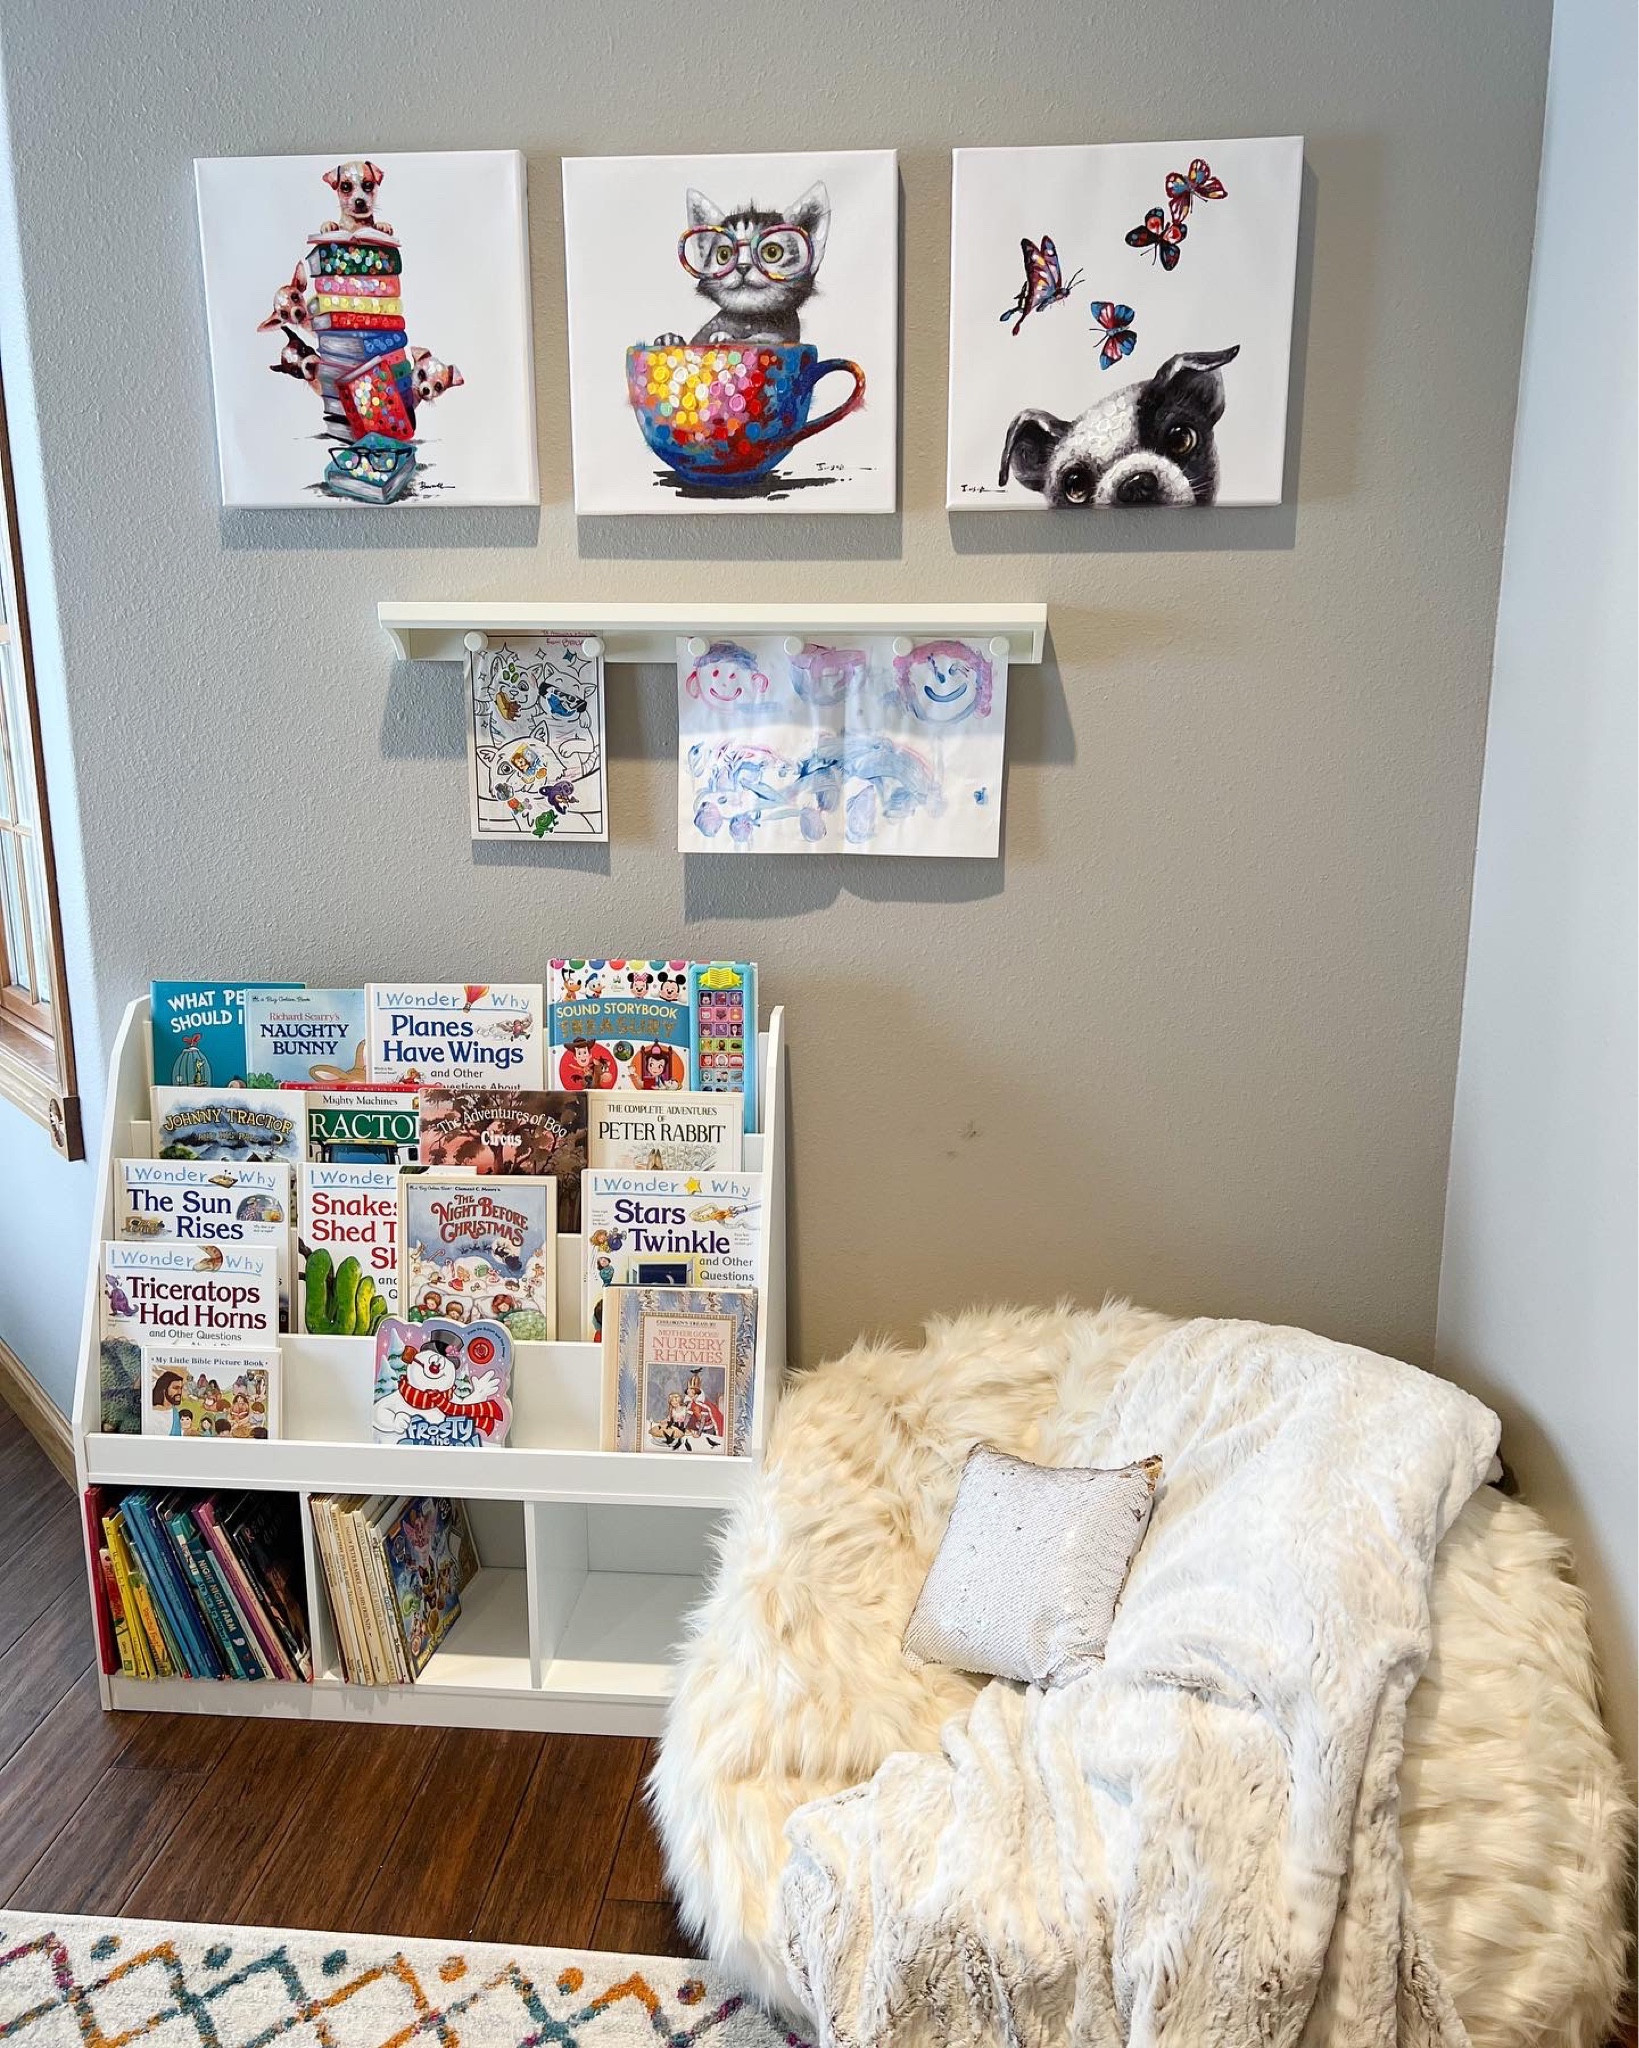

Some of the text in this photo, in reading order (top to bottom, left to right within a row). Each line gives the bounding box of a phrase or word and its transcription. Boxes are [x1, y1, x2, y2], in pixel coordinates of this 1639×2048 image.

[167, 990, 215, 1012] WHAT
[376, 991, 530, 1009] I Wonder Why
[556, 1002, 679, 1019] SOUND STORYBOOK
[170, 1009, 243, 1034] SHOULD I
[269, 1012, 340, 1022] Richard Scarry's
[391, 1014, 473, 1037] Planes
[260, 1023, 349, 1038] NAUGHTY
[272, 1040, 338, 1055] BUNNY
[383, 1040, 524, 1070] Have Wings
[430, 1068, 484, 1079] and Other
[322, 1094, 398, 1106] Mighty Machines
[608, 1104, 718, 1116] THE COMPLETE ADVENTURES
[163, 1108, 294, 1134] JOHNNY TRACTOR
[436, 1107, 568, 1138] The Adventures of Boo
[481, 1130, 522, 1147] Circus
[599, 1121, 726, 1144] PETER RABBIT
[125, 1164, 276, 1188] I Wonder Why
[310, 1169, 395, 1186] I Wonder
[593, 1176, 751, 1197] I Wonder Why
[126, 1188, 231, 1214] The Sun
[454, 1194, 475, 1205] THE
[430, 1196, 529, 1232] NIGHT BEFORE
[614, 1199, 686, 1225] Stars
[176, 1215, 244, 1240] Rises
[311, 1219, 376, 1243] Shed
[440, 1219, 524, 1247] CHRISTMAS
[628, 1228, 731, 1254] Twinkle
[111, 1249, 264, 1273] I Wonder Why
[699, 1256, 753, 1267] and Other
[700, 1270, 755, 1282] Questions
[126, 1276, 260, 1308] Triceratops
[139, 1303, 267, 1330] Had Horns
[149, 1329, 242, 1341] and Other Questions
[652, 1336, 726, 1351] NURSERY
[155, 1356, 264, 1367] My Little Bible Picture Book
[654, 1349, 724, 1364] RHYMES
[408, 1415, 473, 1441] FROSTY
[197, 1558, 237, 1632] NIGHT NIGHT FARM
